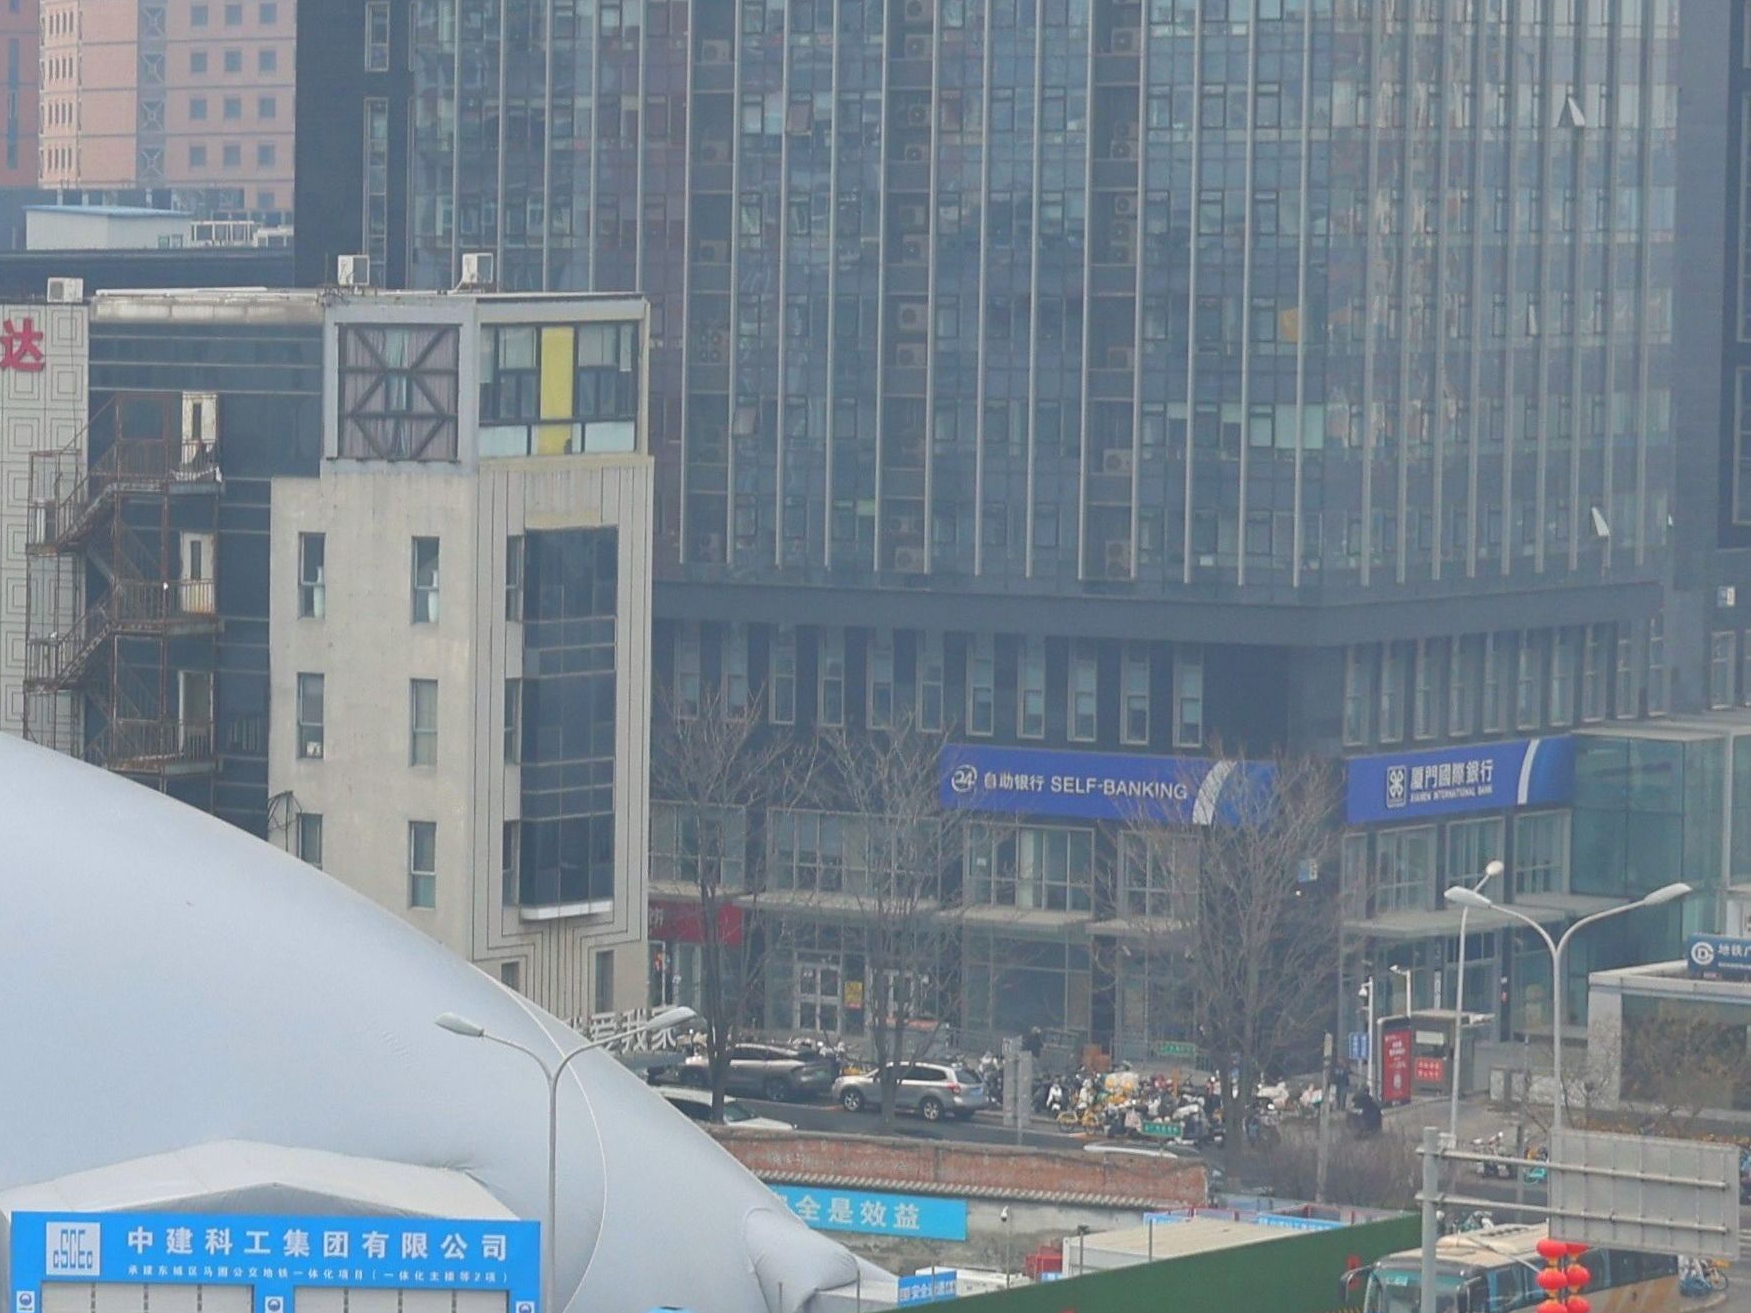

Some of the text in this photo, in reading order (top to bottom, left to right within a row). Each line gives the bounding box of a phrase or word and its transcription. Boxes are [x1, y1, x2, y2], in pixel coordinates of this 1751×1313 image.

[983, 771, 1045, 792] 自助银行
[1050, 774, 1189, 801] SELF-BANKING
[127, 1225, 507, 1262] 中建科工集团有限公司
